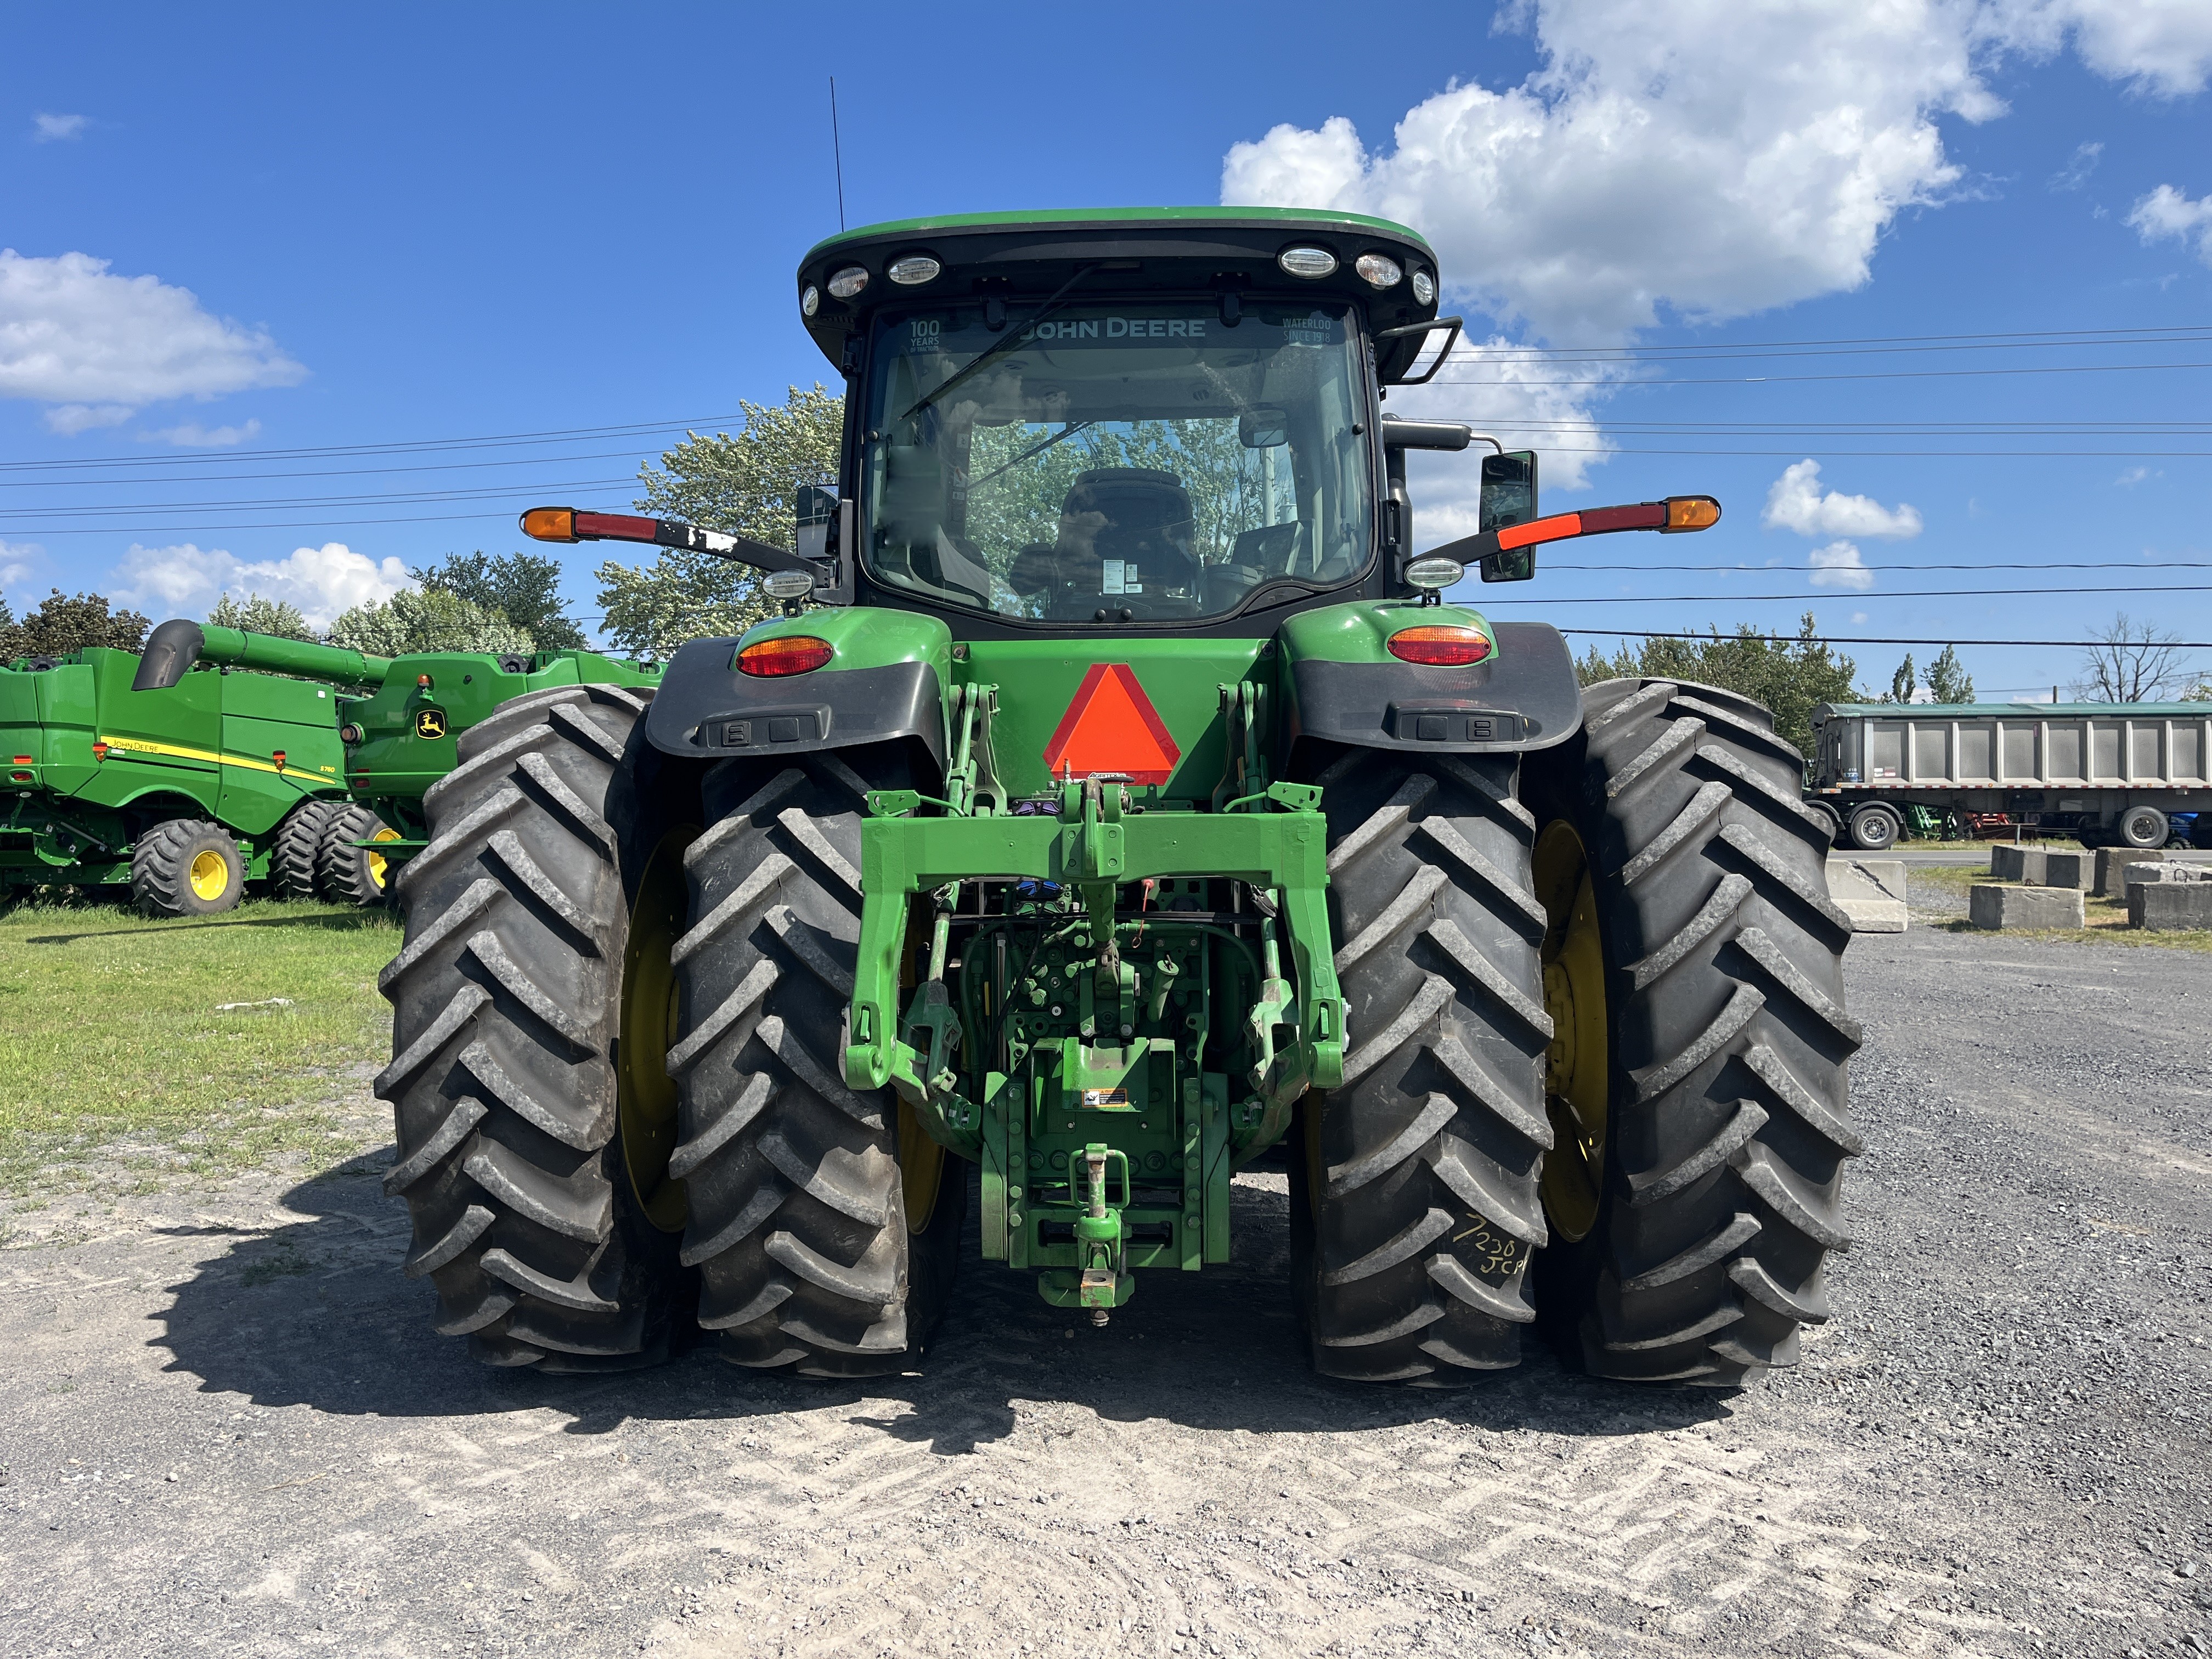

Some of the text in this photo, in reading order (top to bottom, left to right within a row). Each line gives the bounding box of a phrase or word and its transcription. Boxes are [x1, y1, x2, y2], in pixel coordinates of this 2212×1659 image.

[911, 320, 940, 337] 100
[1020, 317, 1206, 340] JOHN DEERE
[1283, 318, 1331, 330] WATERLOO
[911, 336, 939, 346] YEARS
[1284, 330, 1330, 343] SINCE 1918
[112, 740, 133, 749] JOHN
[134, 742, 159, 752] DEERE
